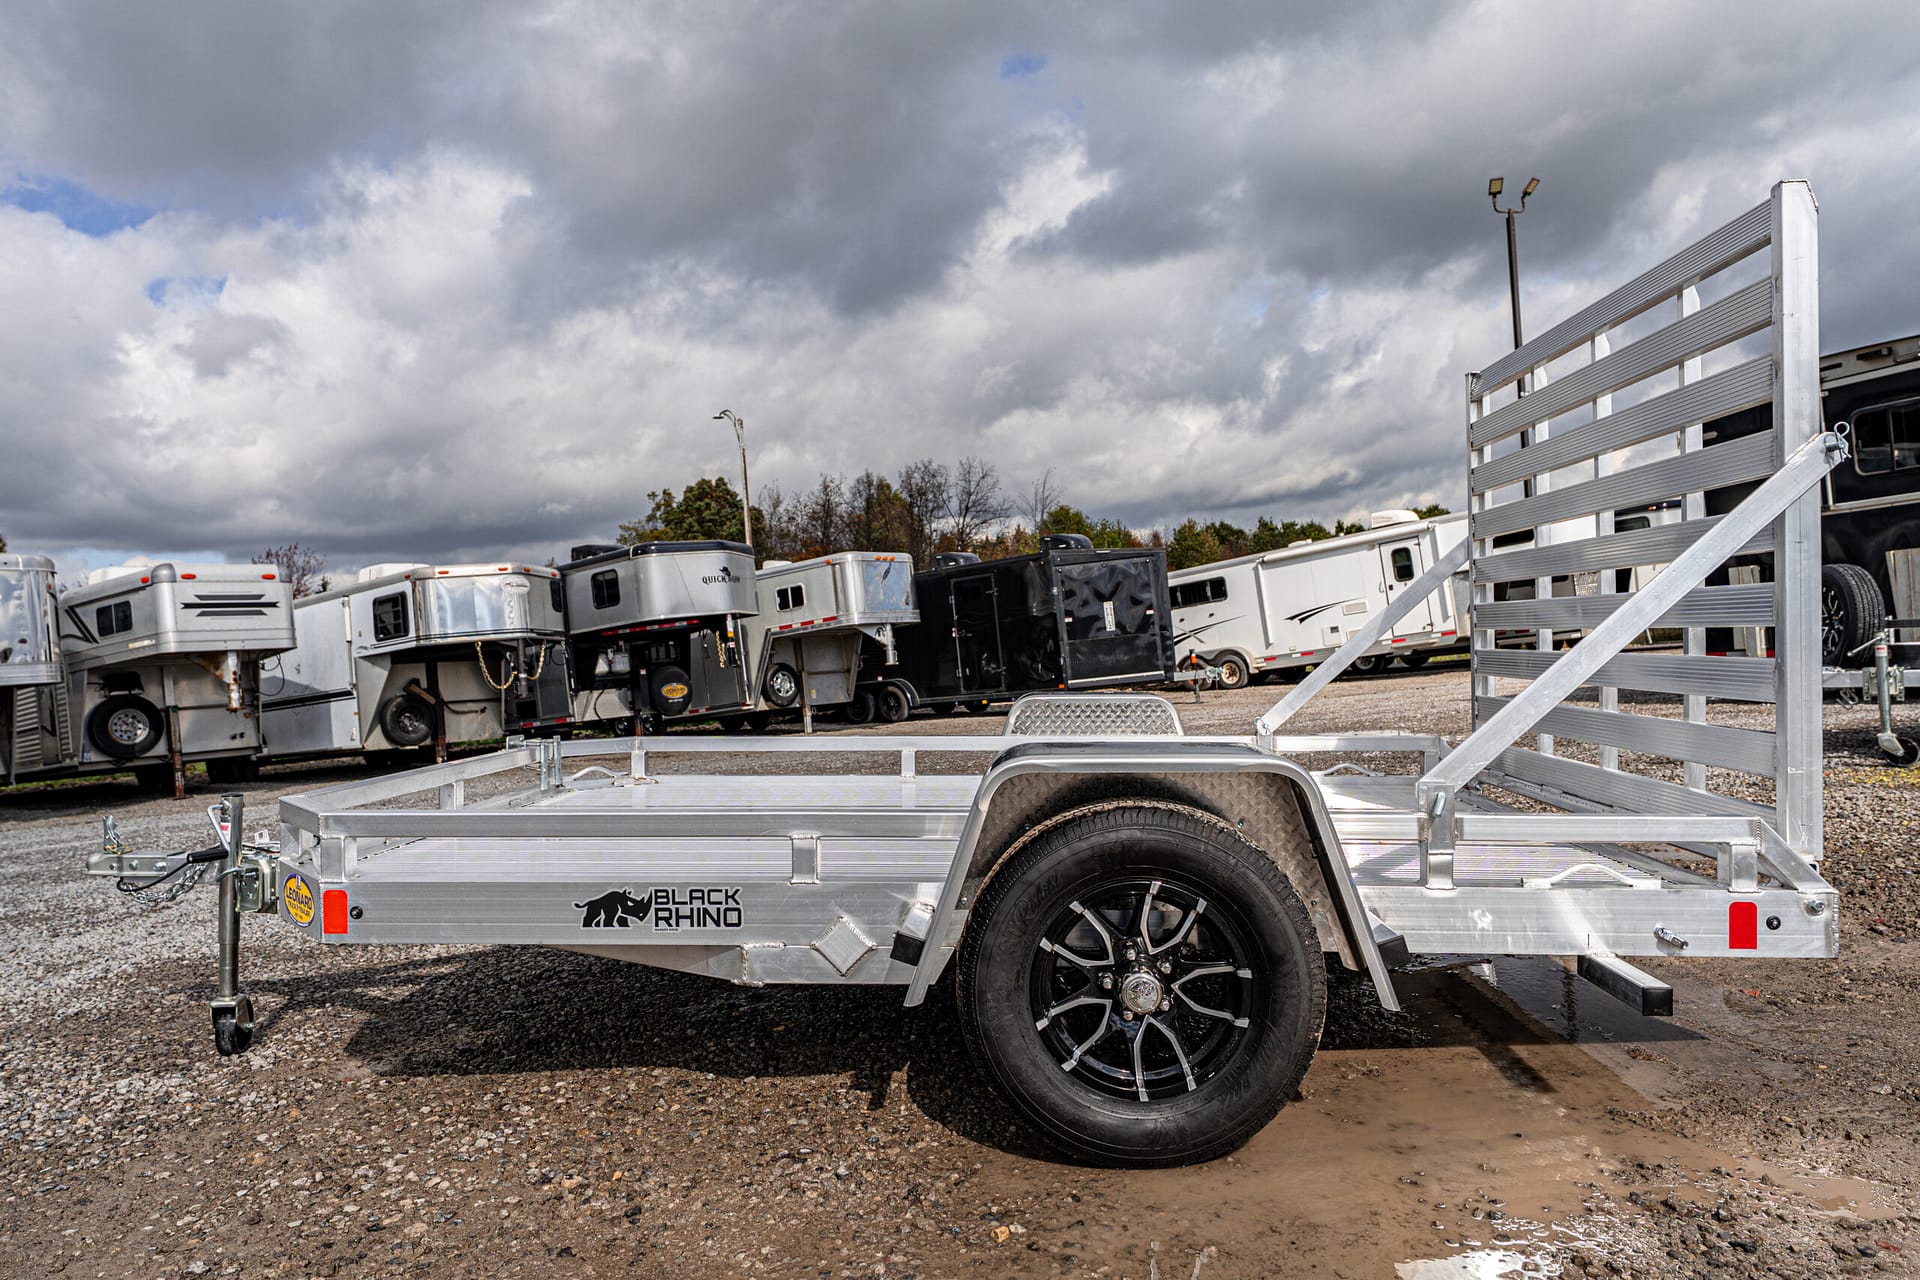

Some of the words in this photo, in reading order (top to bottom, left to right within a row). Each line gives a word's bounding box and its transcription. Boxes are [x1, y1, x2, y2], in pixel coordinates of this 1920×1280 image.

[702, 575, 727, 585] QUICK
[286, 885, 312, 910] LEONARD
[654, 888, 741, 906] BLACK
[654, 907, 742, 928] RHINO
